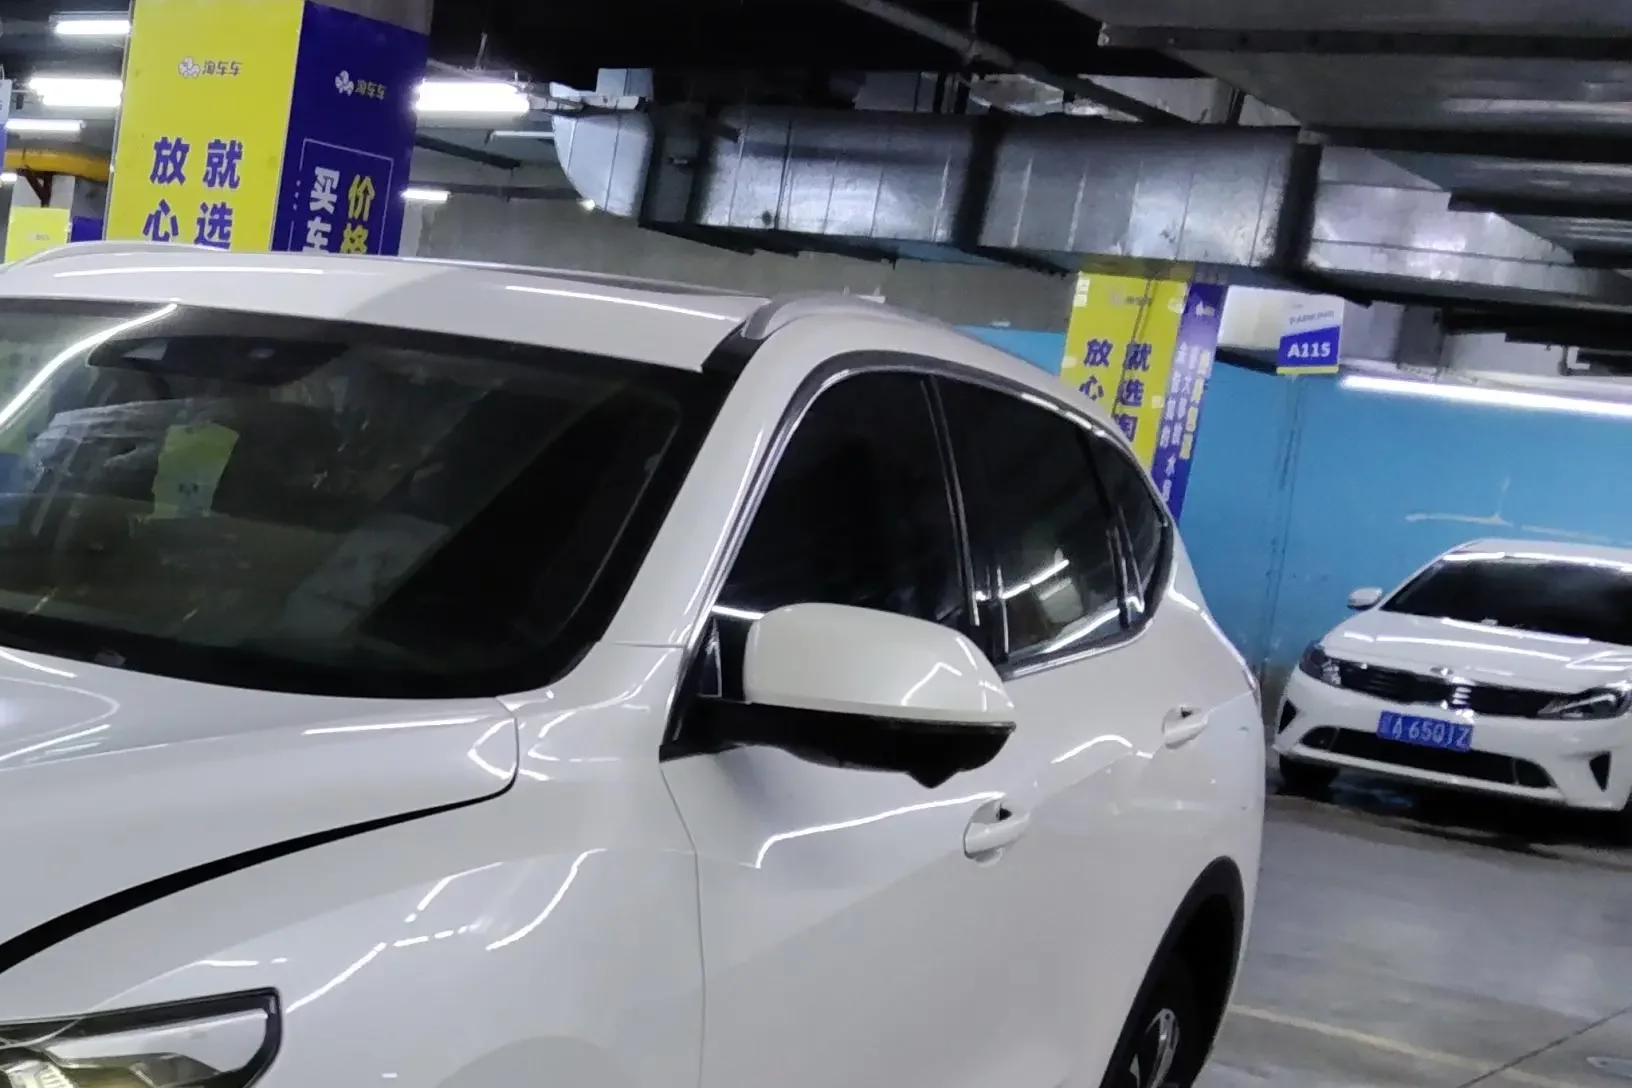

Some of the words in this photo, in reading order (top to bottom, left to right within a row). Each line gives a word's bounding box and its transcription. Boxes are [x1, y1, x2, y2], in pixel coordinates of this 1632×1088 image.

[202, 60, 244, 77] 淘车车
[1287, 342, 1331, 358] A115
[1078, 338, 1114, 401] 放心
